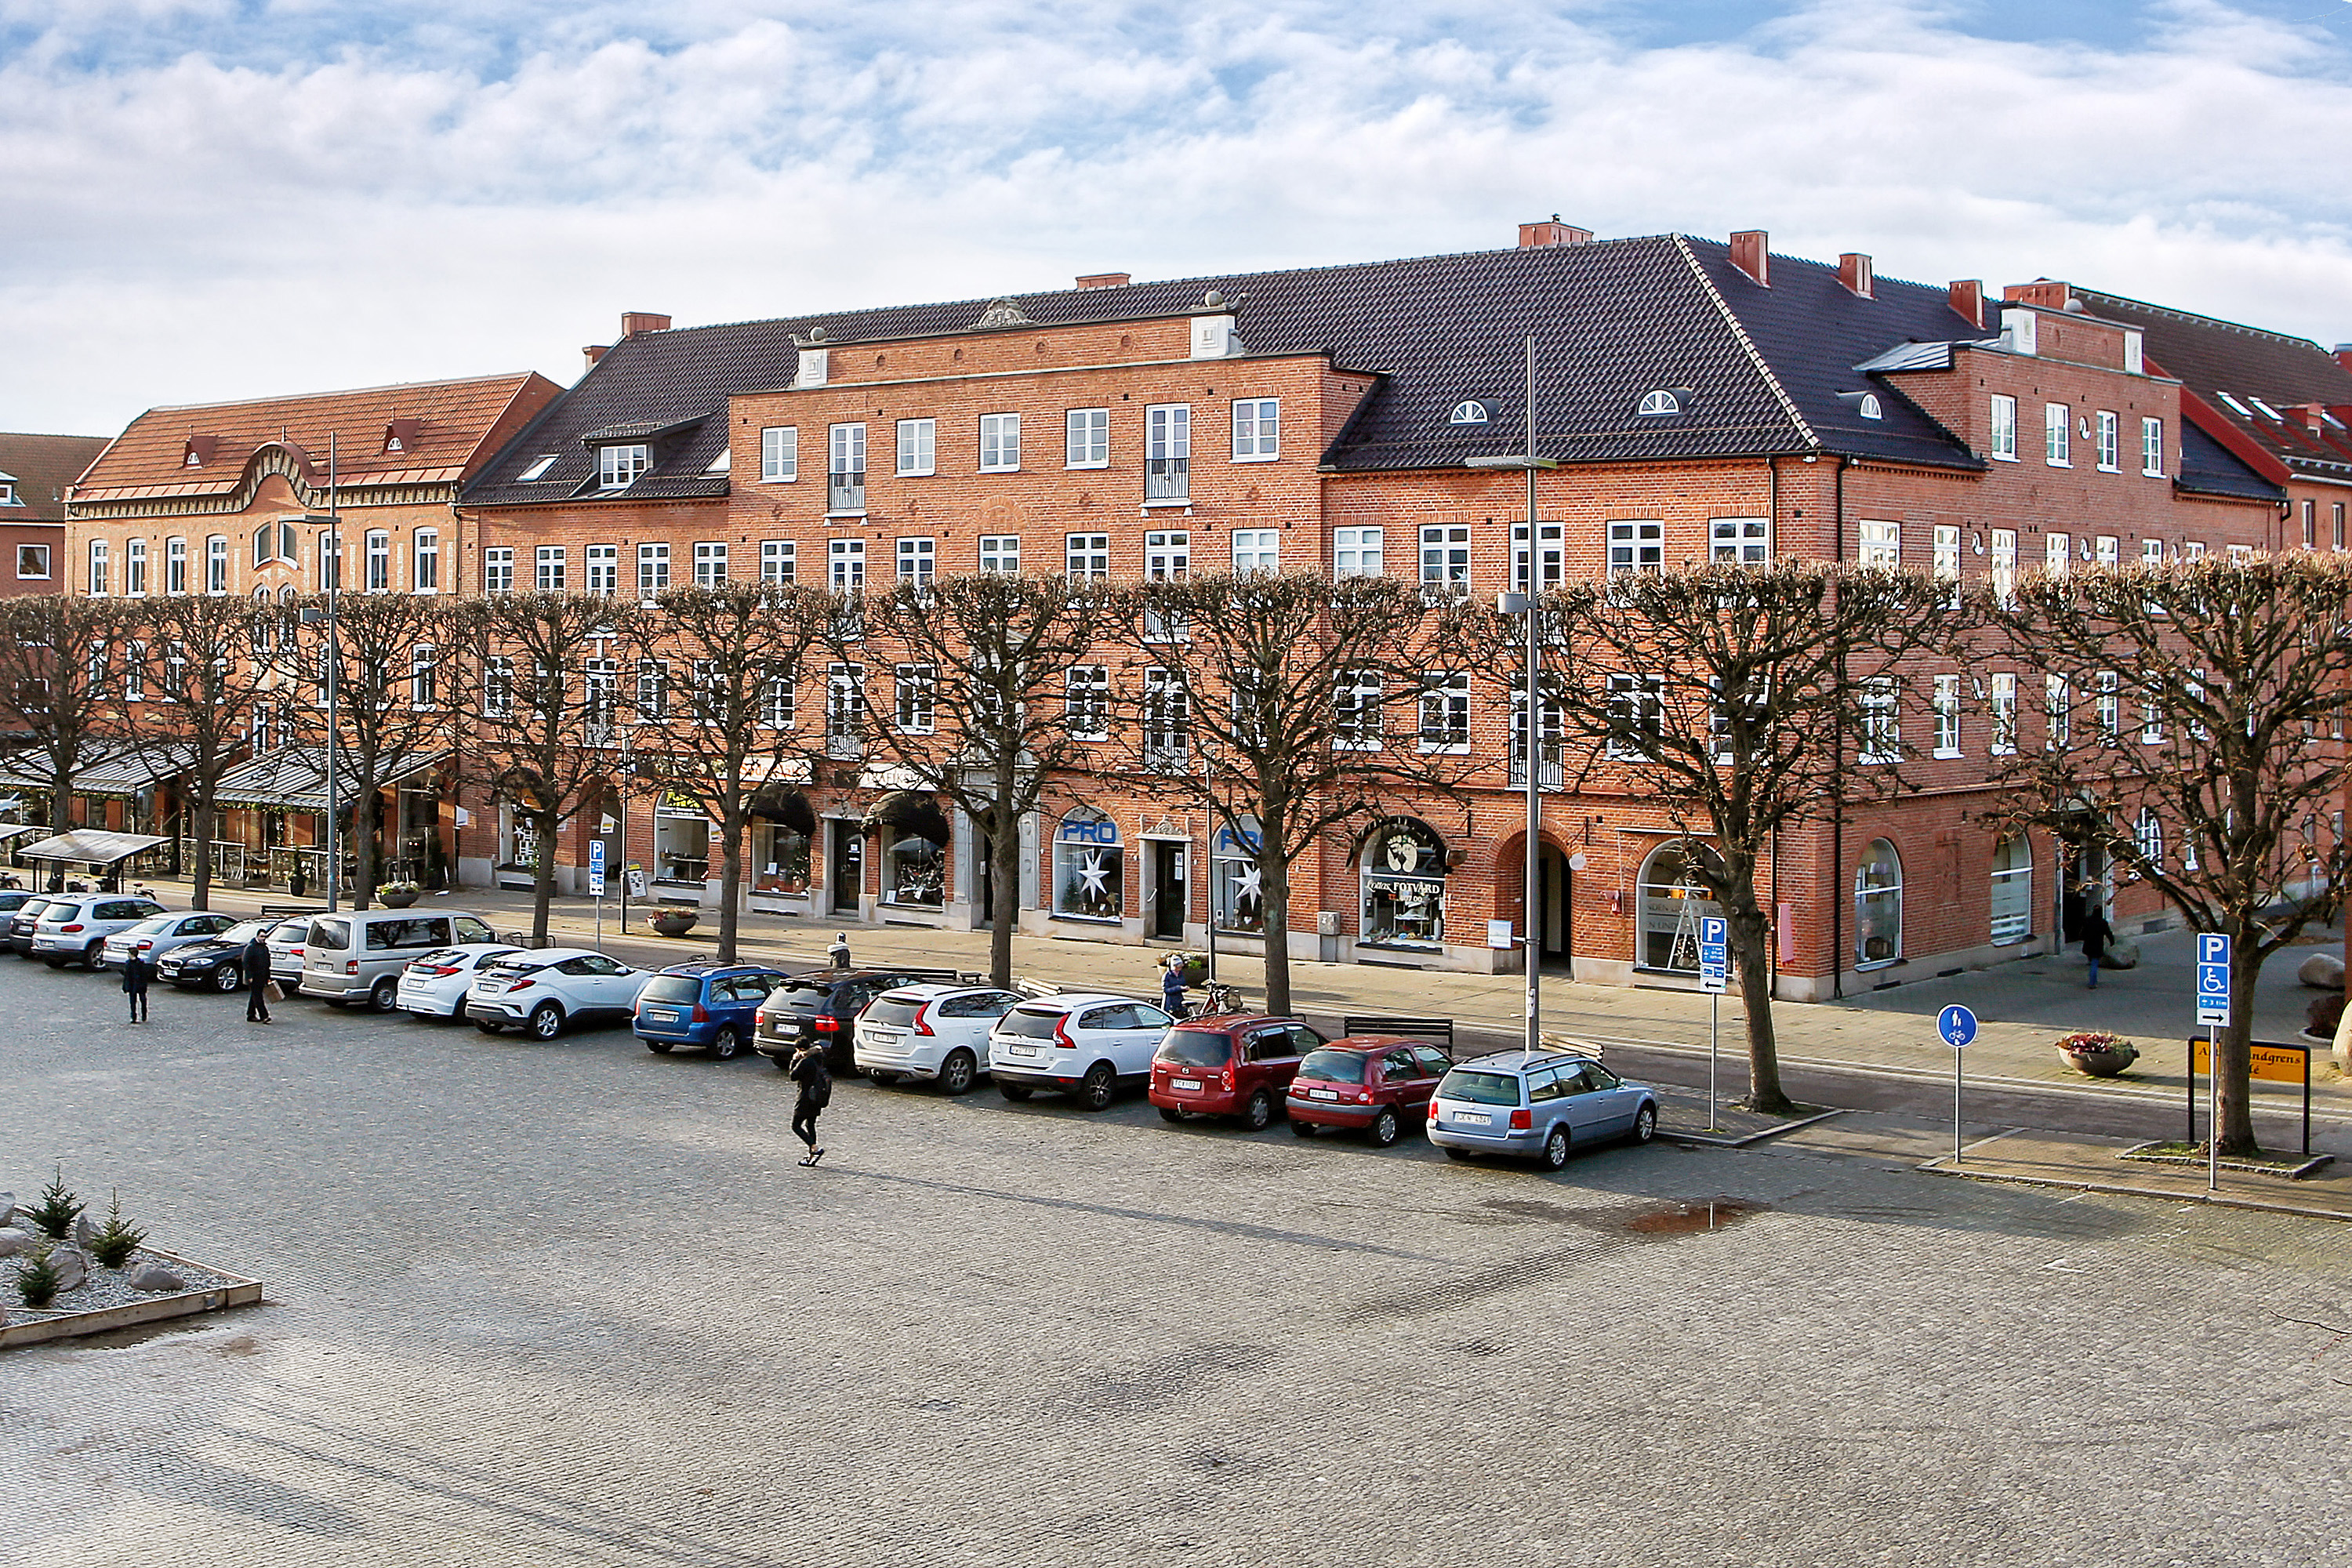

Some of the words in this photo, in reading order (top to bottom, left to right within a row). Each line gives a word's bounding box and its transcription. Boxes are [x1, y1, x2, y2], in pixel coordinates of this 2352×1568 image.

[1062, 820, 1116, 844] PRO
[593, 842, 602, 858] P
[1707, 920, 1722, 942] P
[2206, 937, 2224, 961] P
